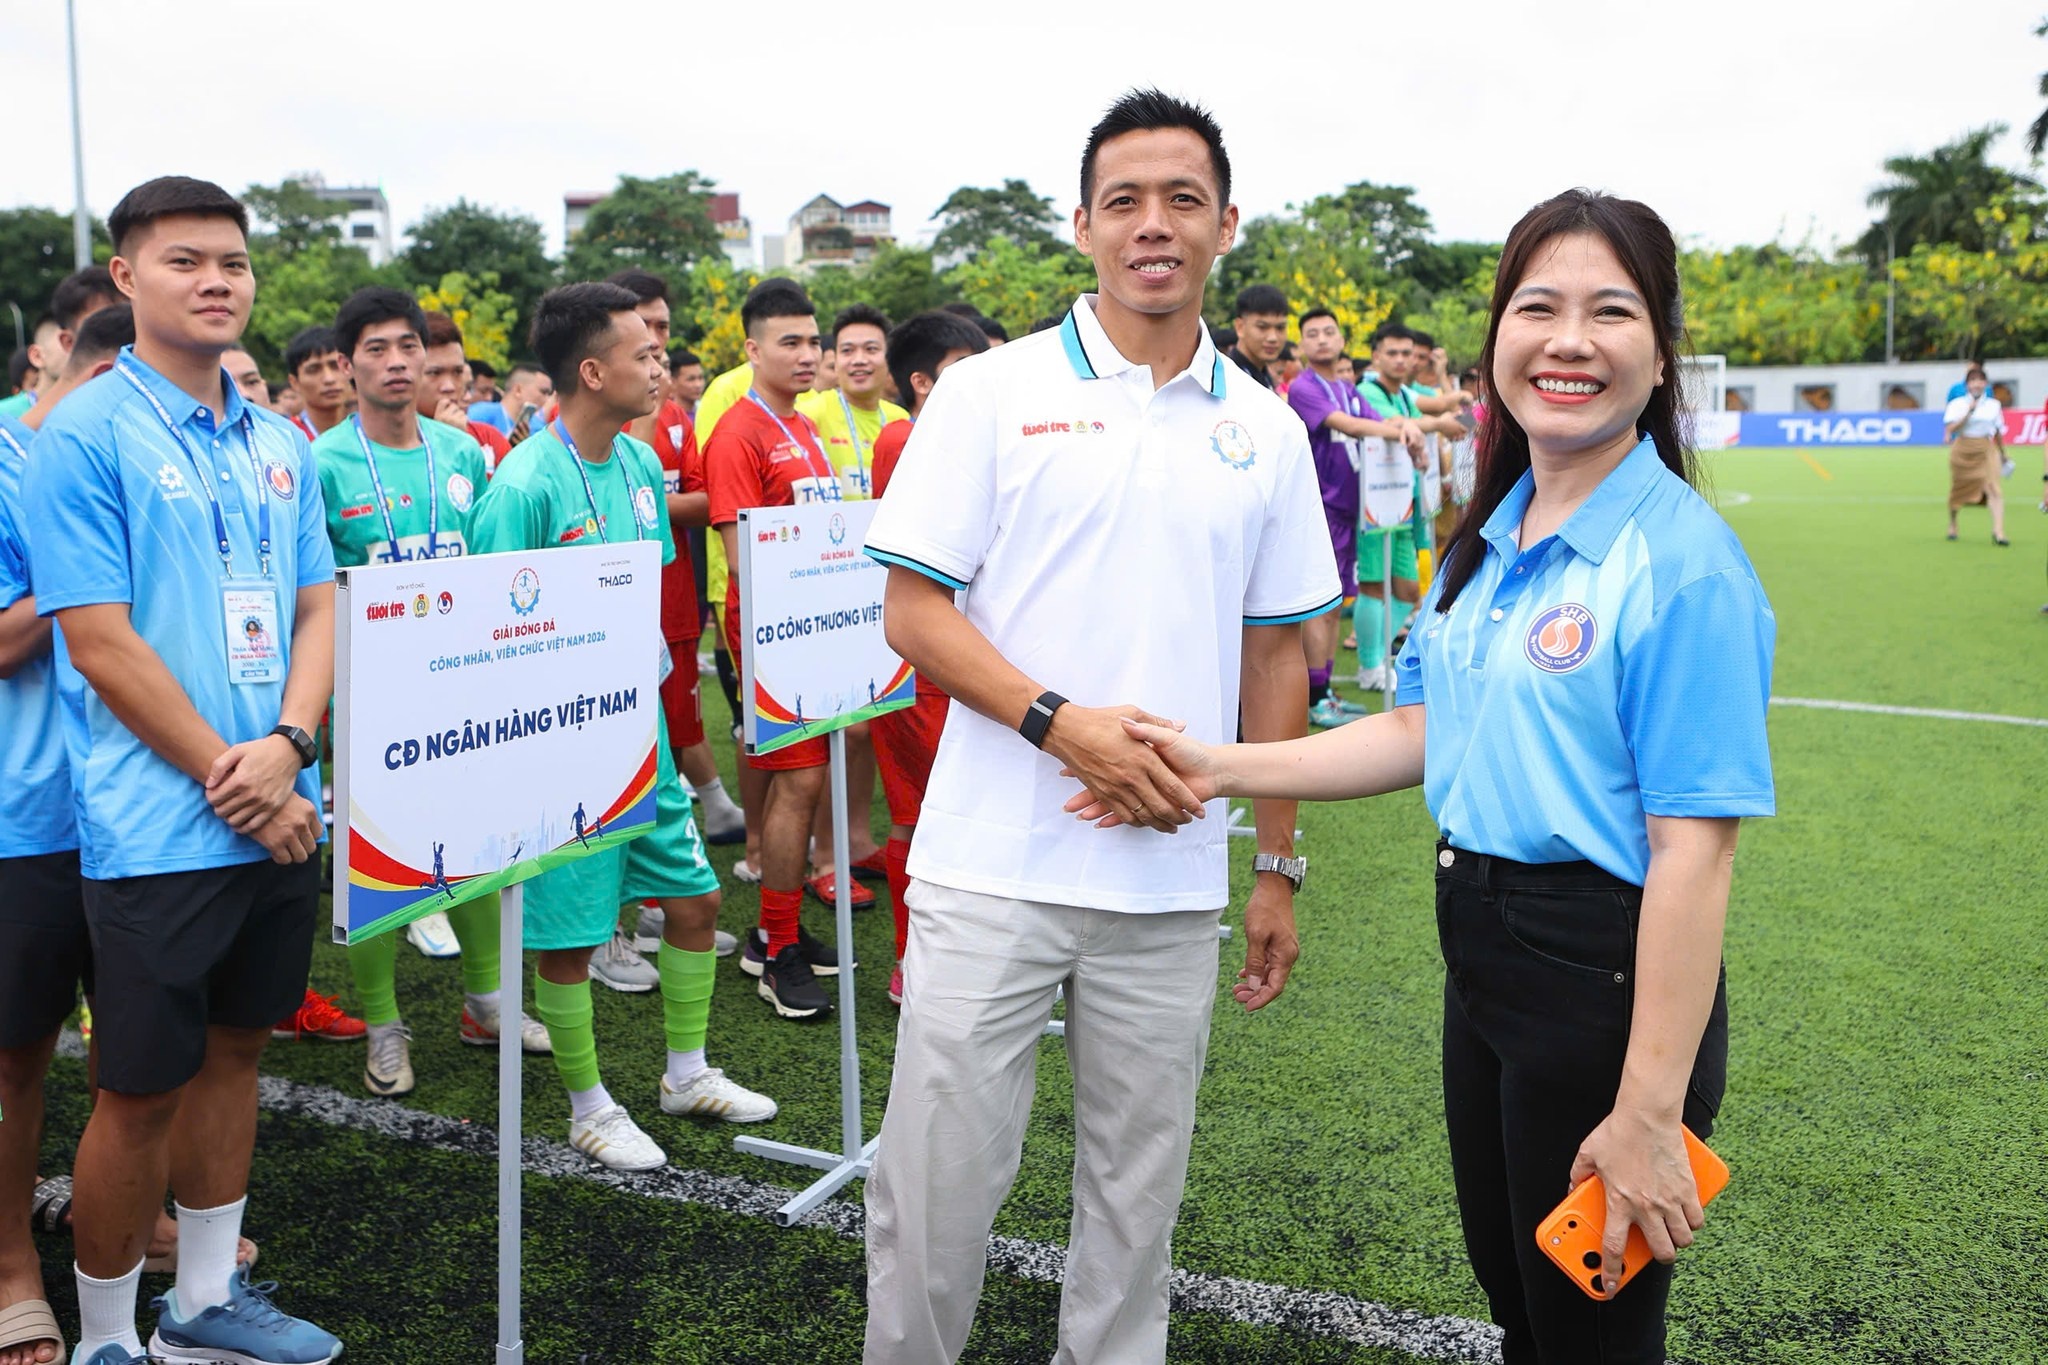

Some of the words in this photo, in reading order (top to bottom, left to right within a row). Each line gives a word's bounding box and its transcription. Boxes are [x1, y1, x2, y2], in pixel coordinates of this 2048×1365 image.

[1778, 418, 1912, 443] THACO
[598, 574, 633, 588] THACO
[756, 624, 774, 645] CĐ
[777, 616, 812, 641] CÔNG
[814, 608, 860, 633] THƯƠNG
[861, 601, 883, 627] VIỆT
[1559, 607, 1589, 624] SHB
[493, 624, 513, 640] GIẢI
[515, 622, 541, 637] BÓNG
[543, 618, 556, 632] ĐÁ
[429, 656, 461, 672] CÔNG
[463, 650, 494, 667] NHÂN,
[496, 645, 517, 660] VIÊN
[519, 639, 545, 655] CHỨC
[546, 636, 565, 653] VIỆT
[567, 634, 586, 648] NAM
[587, 631, 606, 644] 2026
[384, 739, 420, 771] CĐ
[426, 719, 490, 761] NGÂN
[495, 708, 551, 745] HÀNG
[556, 694, 596, 731] VIỆT
[599, 687, 637, 719] NAM
